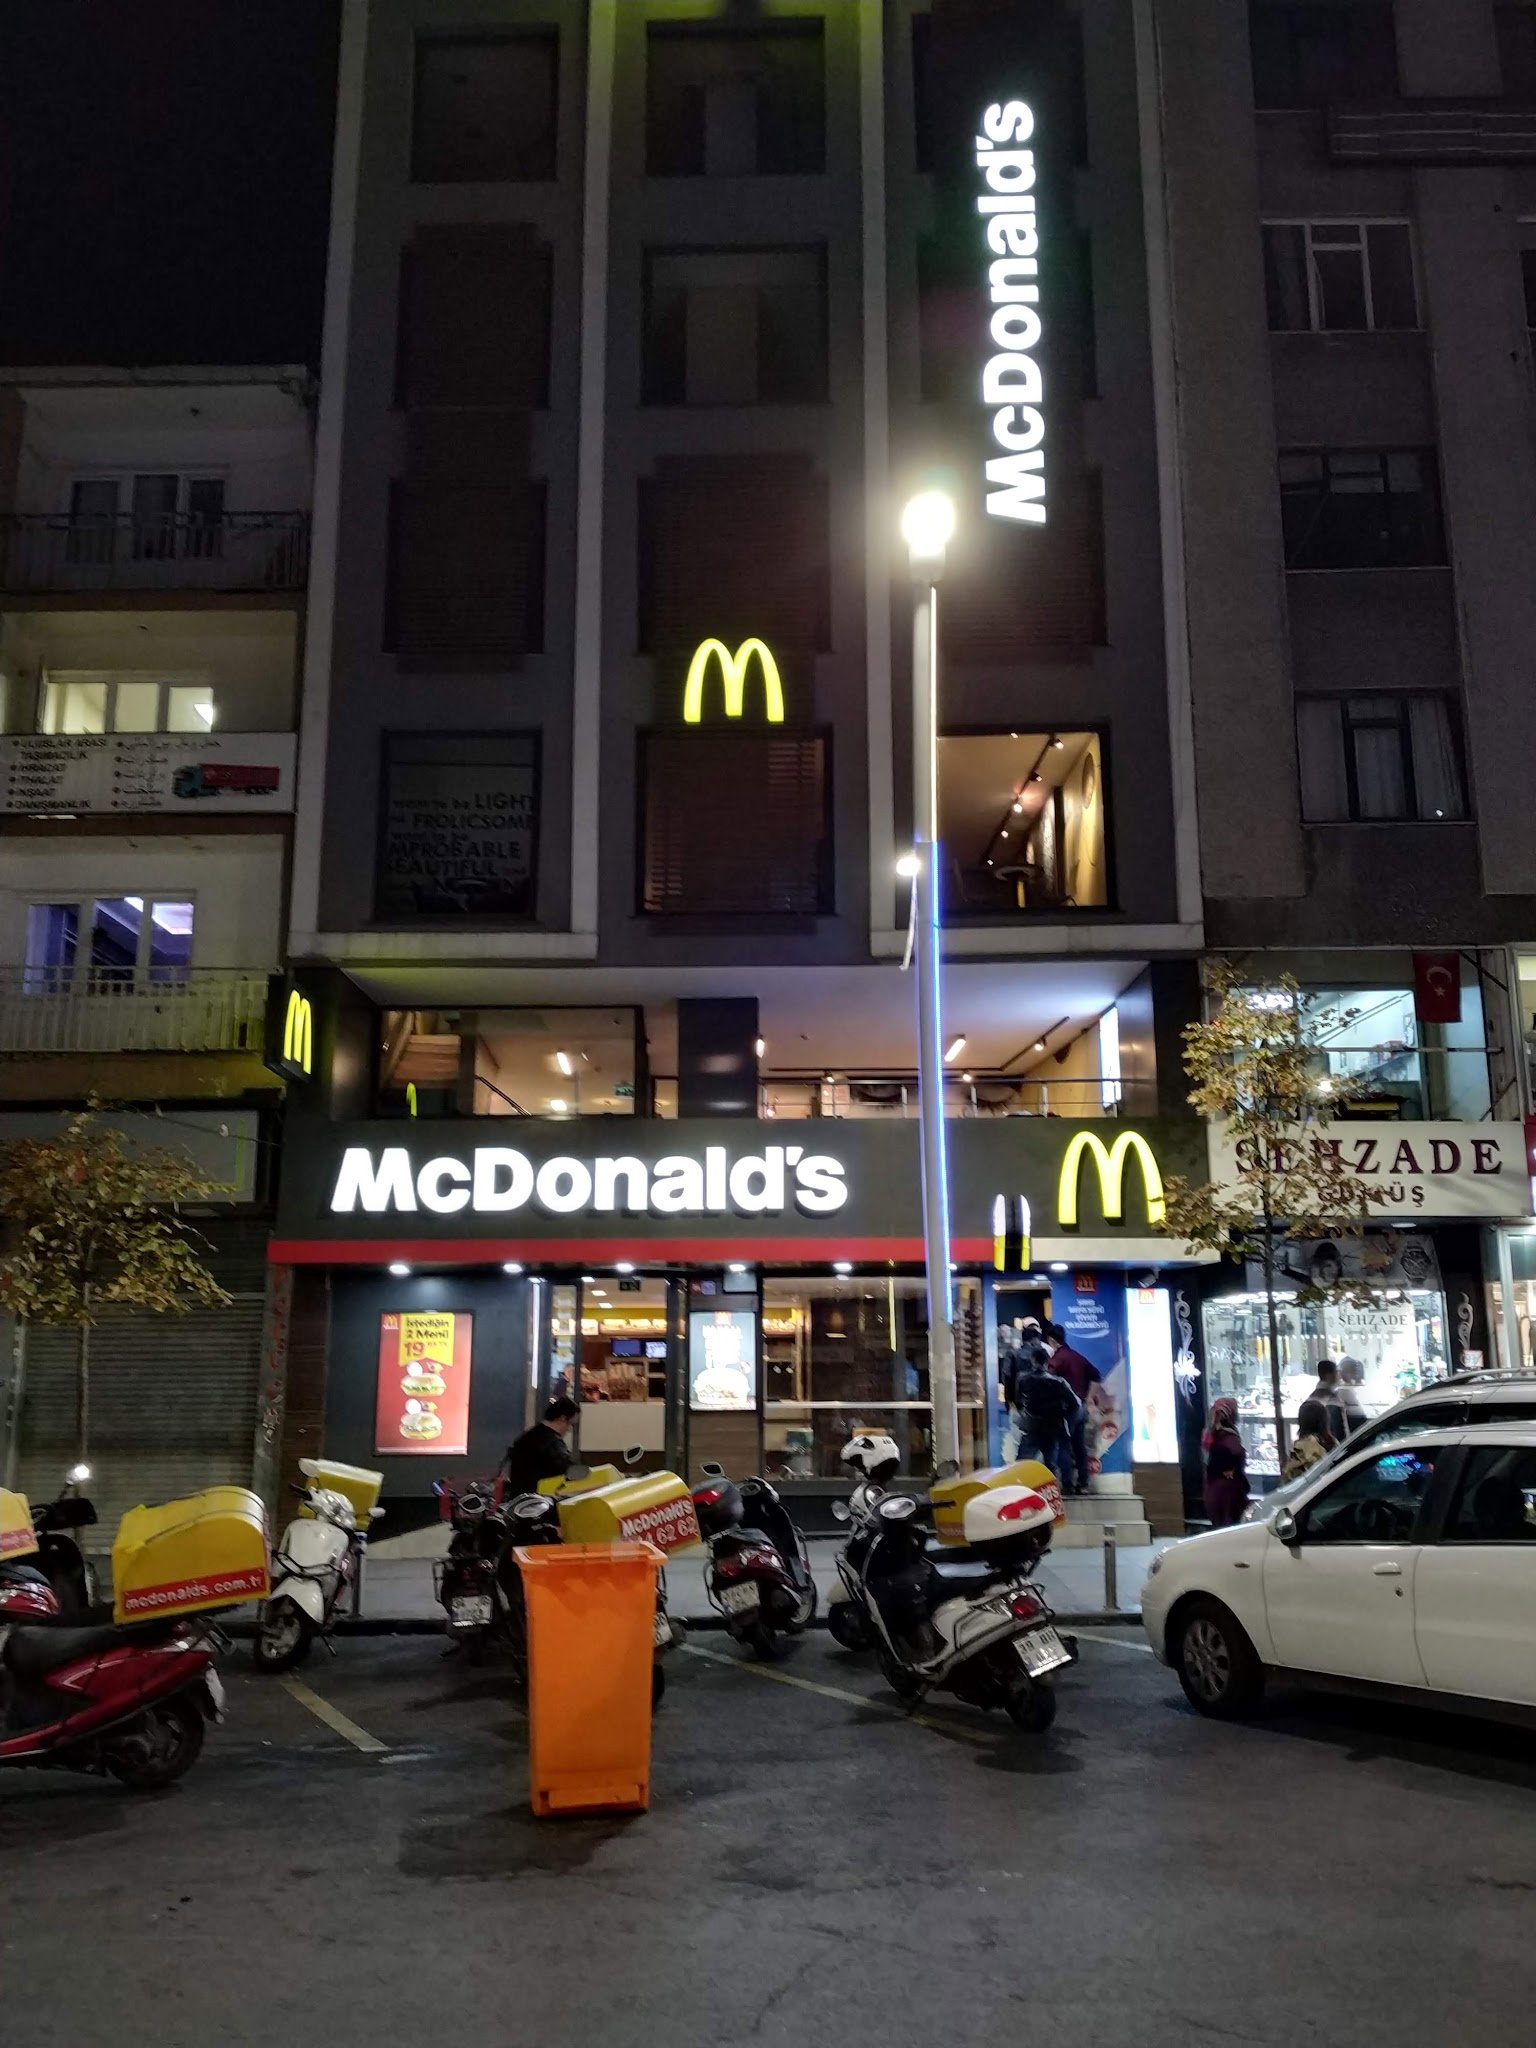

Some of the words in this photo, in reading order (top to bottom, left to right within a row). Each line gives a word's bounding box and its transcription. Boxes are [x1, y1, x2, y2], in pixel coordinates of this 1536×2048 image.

[976, 100, 1047, 525] McDonald's
[330, 1146, 849, 1213] McDonald's
[404, 1341, 425, 1357] 19
